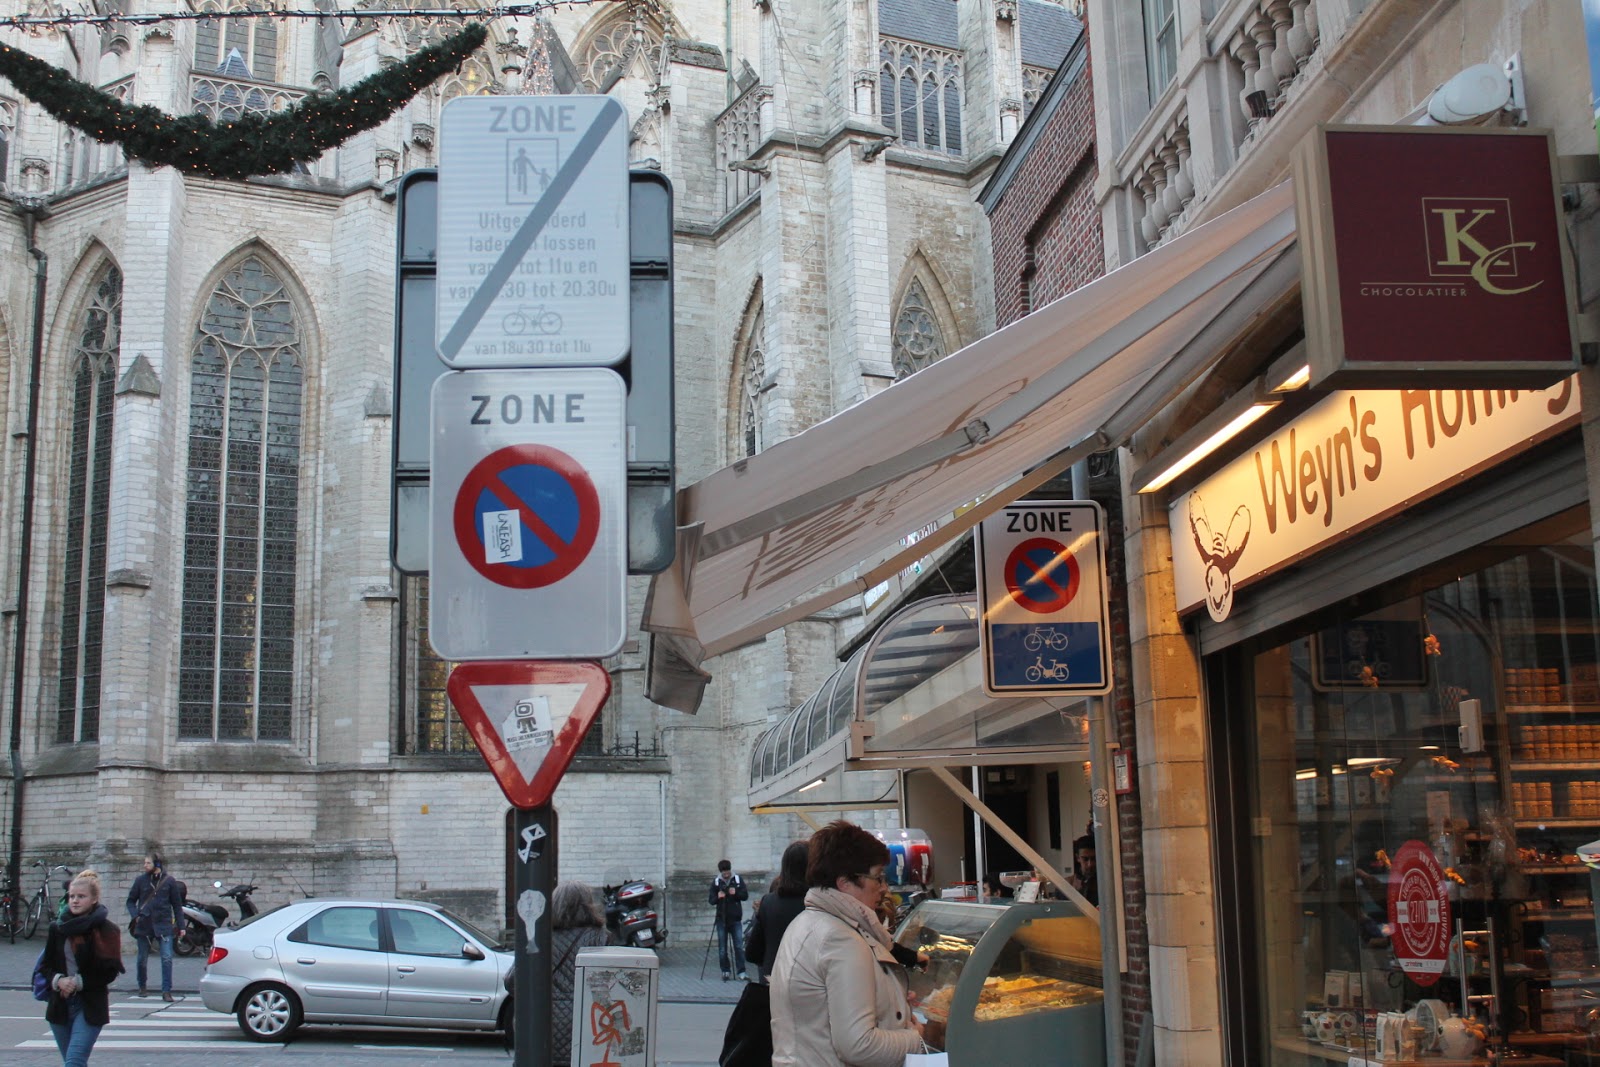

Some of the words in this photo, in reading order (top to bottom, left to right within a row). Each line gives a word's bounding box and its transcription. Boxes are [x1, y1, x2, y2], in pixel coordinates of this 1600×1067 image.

[489, 105, 576, 132] ZONE
[543, 235, 597, 251] lossen
[578, 262, 598, 274] en
[533, 281, 556, 297] tot
[562, 279, 618, 298] 20.30u
[1360, 287, 1468, 297] CHOCOLATIER
[474, 343, 497, 355] van
[549, 341, 568, 354] tot
[470, 393, 585, 425] ZONE
[1254, 395, 1382, 535] Weyn's
[1006, 511, 1072, 533] ZONE
[497, 513, 511, 559] UNLEASH
